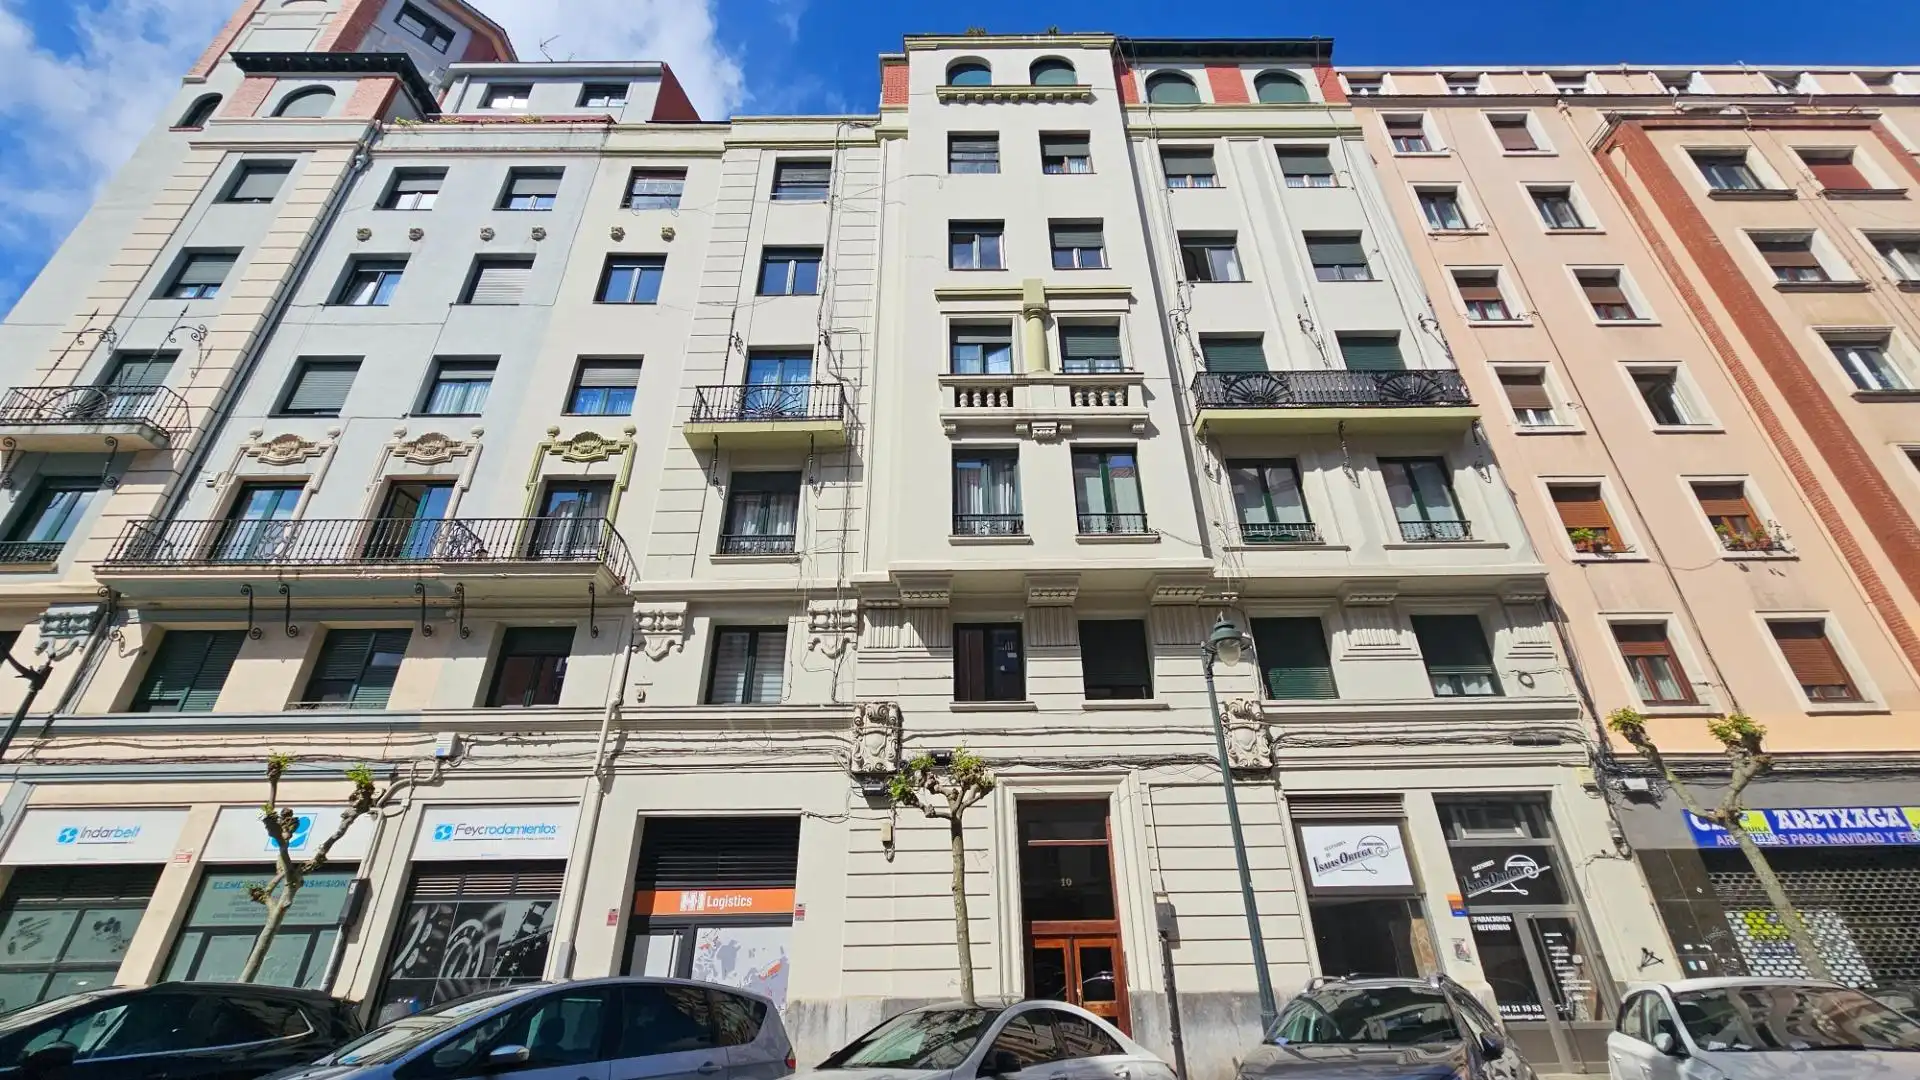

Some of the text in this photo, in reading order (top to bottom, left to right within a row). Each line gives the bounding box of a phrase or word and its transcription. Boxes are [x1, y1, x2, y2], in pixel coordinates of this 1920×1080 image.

[1774, 808, 1907, 828] ARETXAGA
[80, 826, 141, 839] Indarbelt
[454, 823, 557, 836] Feycrodamientos
[1788, 832, 1826, 845] PARA
[1827, 832, 1883, 844] NAVIDAD
[1060, 878, 1072, 887] 10
[707, 894, 752, 910] Logistics
